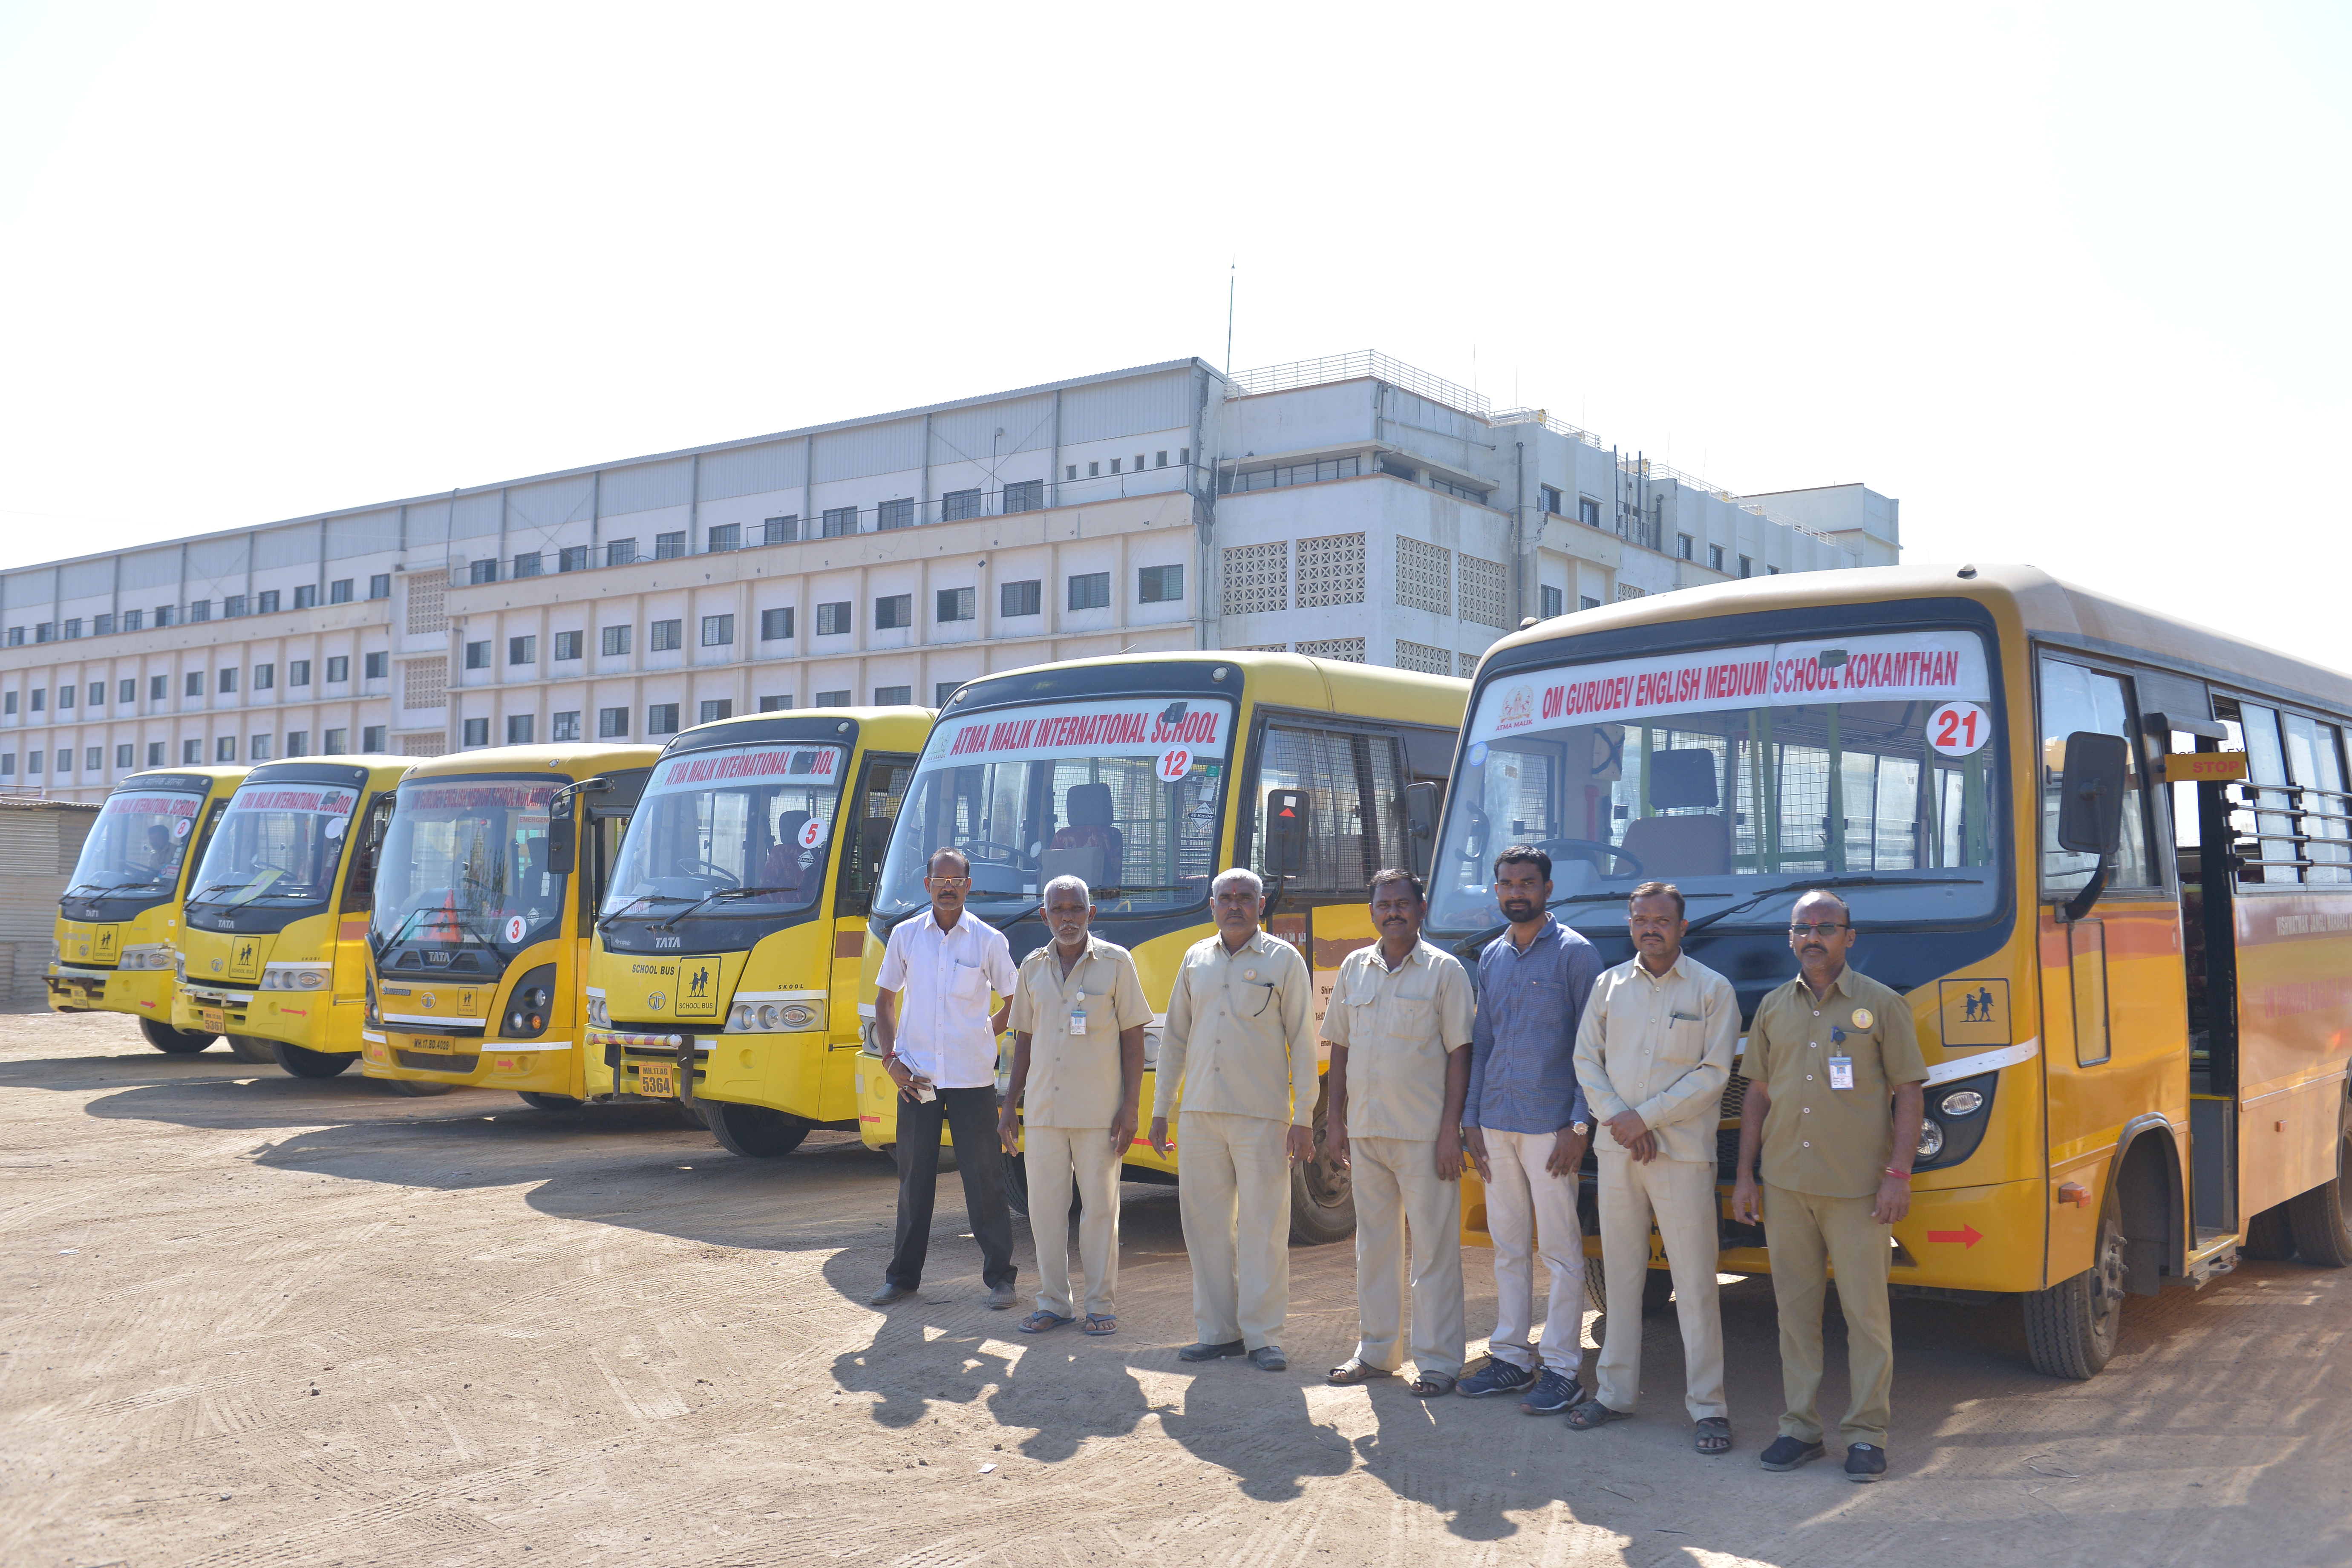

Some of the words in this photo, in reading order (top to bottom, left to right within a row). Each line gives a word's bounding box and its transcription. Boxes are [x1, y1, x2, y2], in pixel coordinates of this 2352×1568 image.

[1542, 686, 1565, 719] OM
[1566, 675, 1635, 716] GURUDEV
[1636, 667, 1702, 707] ENGLISH
[1704, 661, 1769, 700] MEDIUM
[1844, 651, 1959, 689] KOKAMTHAN
[950, 724, 990, 756] ATMA
[988, 719, 1037, 751] MALIK
[1033, 713, 1149, 748] INTERNATIONAL
[1496, 723, 1512, 732] ATMA
[1513, 719, 1533, 728] MALIK
[1936, 710, 1978, 747] 21
[664, 762, 691, 786] ATMA
[686, 758, 719, 783] MALIK
[715, 751, 790, 780] INTERNATIONAL
[1164, 750, 1187, 776] 12
[2193, 761, 2240, 773] STOP
[253, 792, 276, 808] MALIK
[271, 792, 323, 810] INTERNATIONAL
[443, 788, 467, 808] ENGLISH
[466, 787, 490, 807] MEDIUM
[490, 787, 515, 807] SCHOOL
[170, 799, 198, 817] SCHOOL
[177, 822, 186, 834] 8
[805, 824, 819, 844] 5
[218, 919, 234, 928] TATA
[512, 920, 519, 939] 3
[656, 937, 680, 948] TATA
[429, 951, 450, 962] TATA
[632, 964, 657, 974] SCHOOL
[660, 966, 675, 975] BUS
[205, 1020, 222, 1031] 5367
[643, 1077, 670, 1093] 5364
